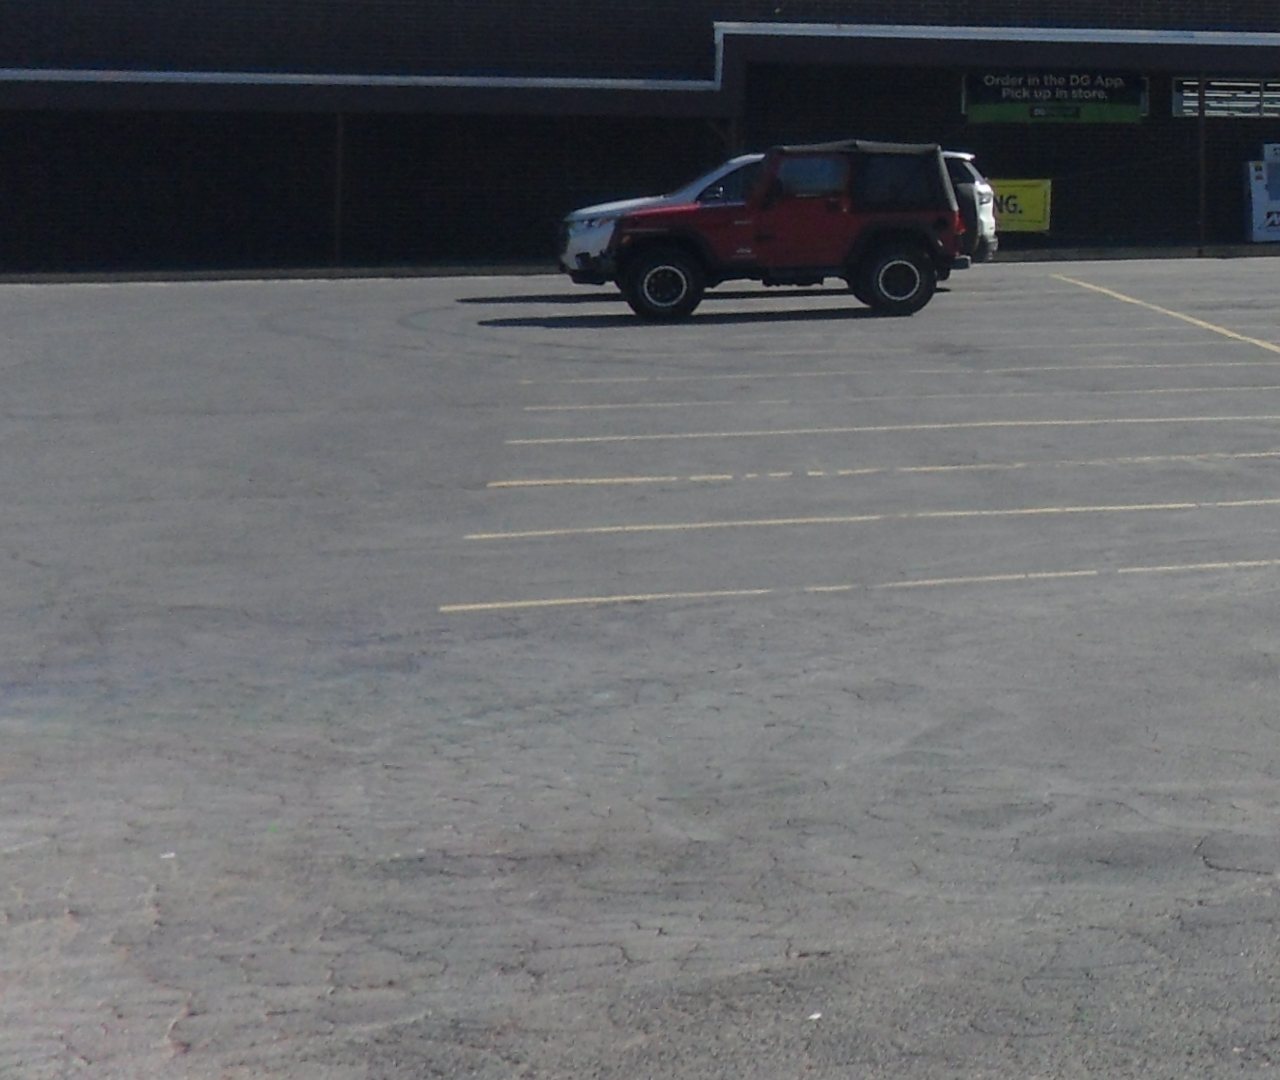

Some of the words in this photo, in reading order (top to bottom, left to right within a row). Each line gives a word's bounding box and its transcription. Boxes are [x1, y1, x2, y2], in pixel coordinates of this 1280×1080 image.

[983, 75, 1023, 86] Order
[1027, 75, 1039, 86] in
[1043, 75, 1066, 87] the
[1069, 75, 1091, 87] DG
[1094, 75, 1126, 88] App.
[1001, 87, 1029, 99] Pick
[1033, 89, 1051, 100] up
[1055, 87, 1068, 99] in
[1071, 88, 1108, 99] store.
